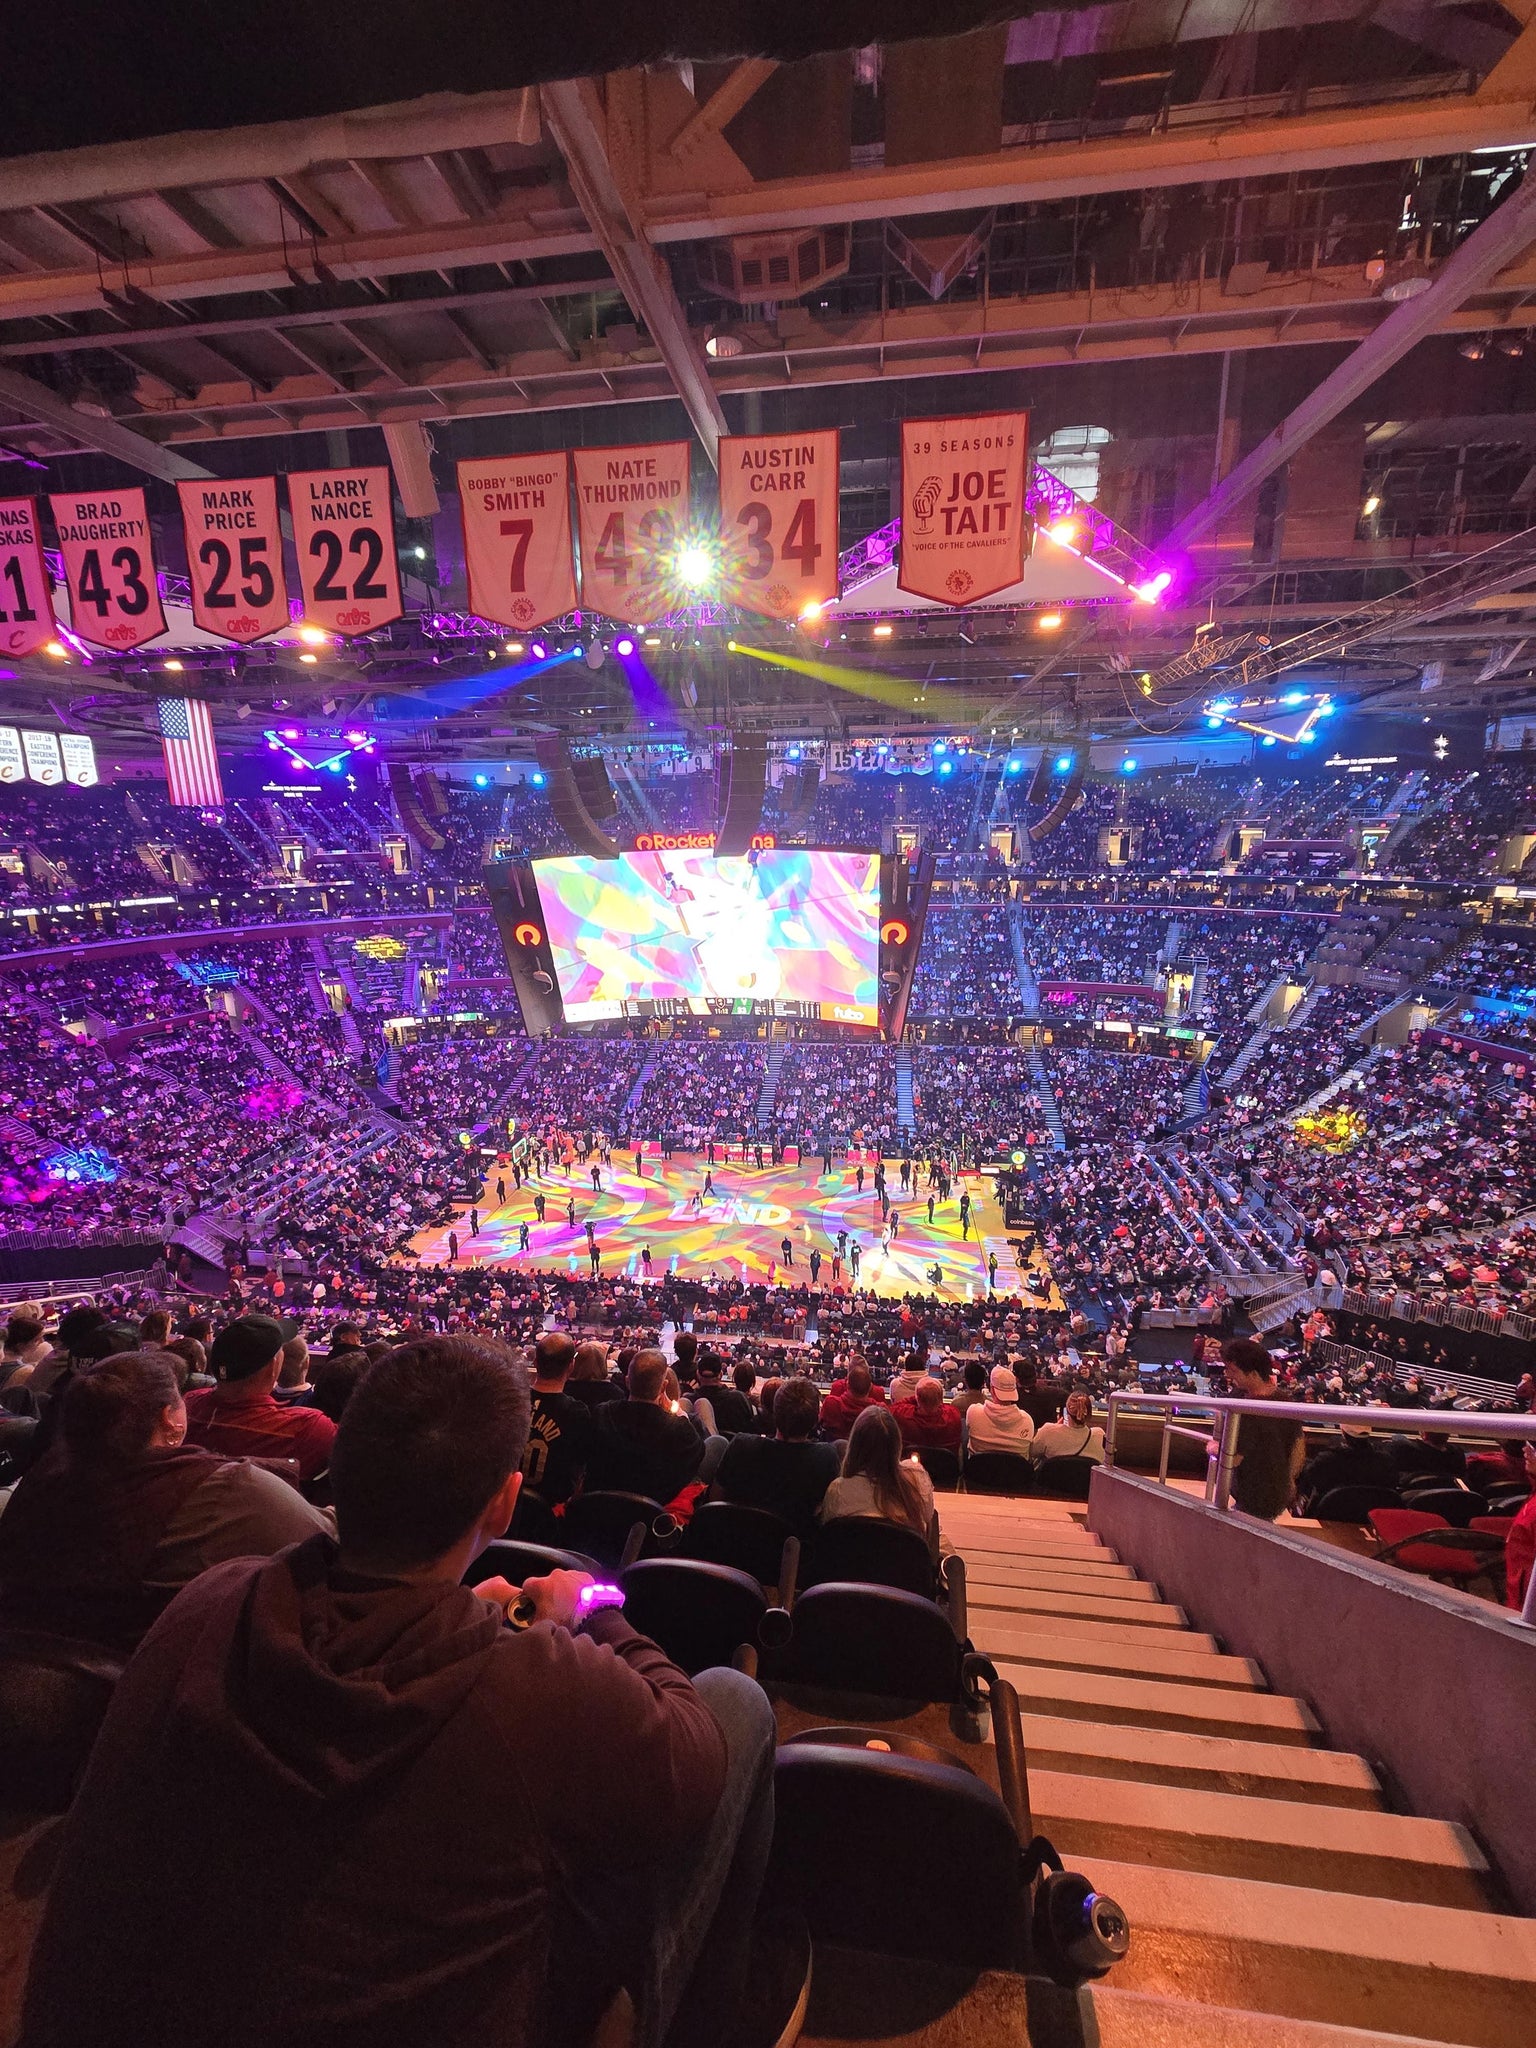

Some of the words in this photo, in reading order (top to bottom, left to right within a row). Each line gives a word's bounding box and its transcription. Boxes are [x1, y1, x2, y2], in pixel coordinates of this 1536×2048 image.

[913, 442, 931, 454] 39
[940, 435, 1015, 452] SEASONS
[740, 446, 815, 469] AUSTIN
[607, 459, 657, 480] NATE
[310, 478, 369, 500] LARRY
[468, 477, 506, 490] BOBBY
[583, 480, 682, 503] THURMOND
[750, 471, 806, 492] CARR
[947, 468, 1007, 502] JOE
[202, 490, 254, 509] MARK
[483, 490, 545, 512] SMITH
[0, 510, 29, 526] NAS
[75, 502, 122, 520] BRAD
[204, 511, 257, 529] PRICE
[311, 501, 373, 521] NANCE
[940, 502, 1012, 536] TAIT
[0, 529, 34, 545] SKAS
[60, 520, 145, 541] DAUGHERTY
[736, 499, 822, 581] 34
[500, 519, 534, 593] 7
[938, 542, 948, 550] OF
[950, 541, 964, 549] THE
[199, 537, 275, 608] 25
[309, 527, 387, 601] 22
[79, 546, 149, 617] 43
[226, 616, 260, 633] CAVS
[336, 607, 371, 626] CAVS
[105, 624, 137, 640] CAVS
[653, 833, 716, 850] Rocket
[530, 1411, 561, 1442] LAND
